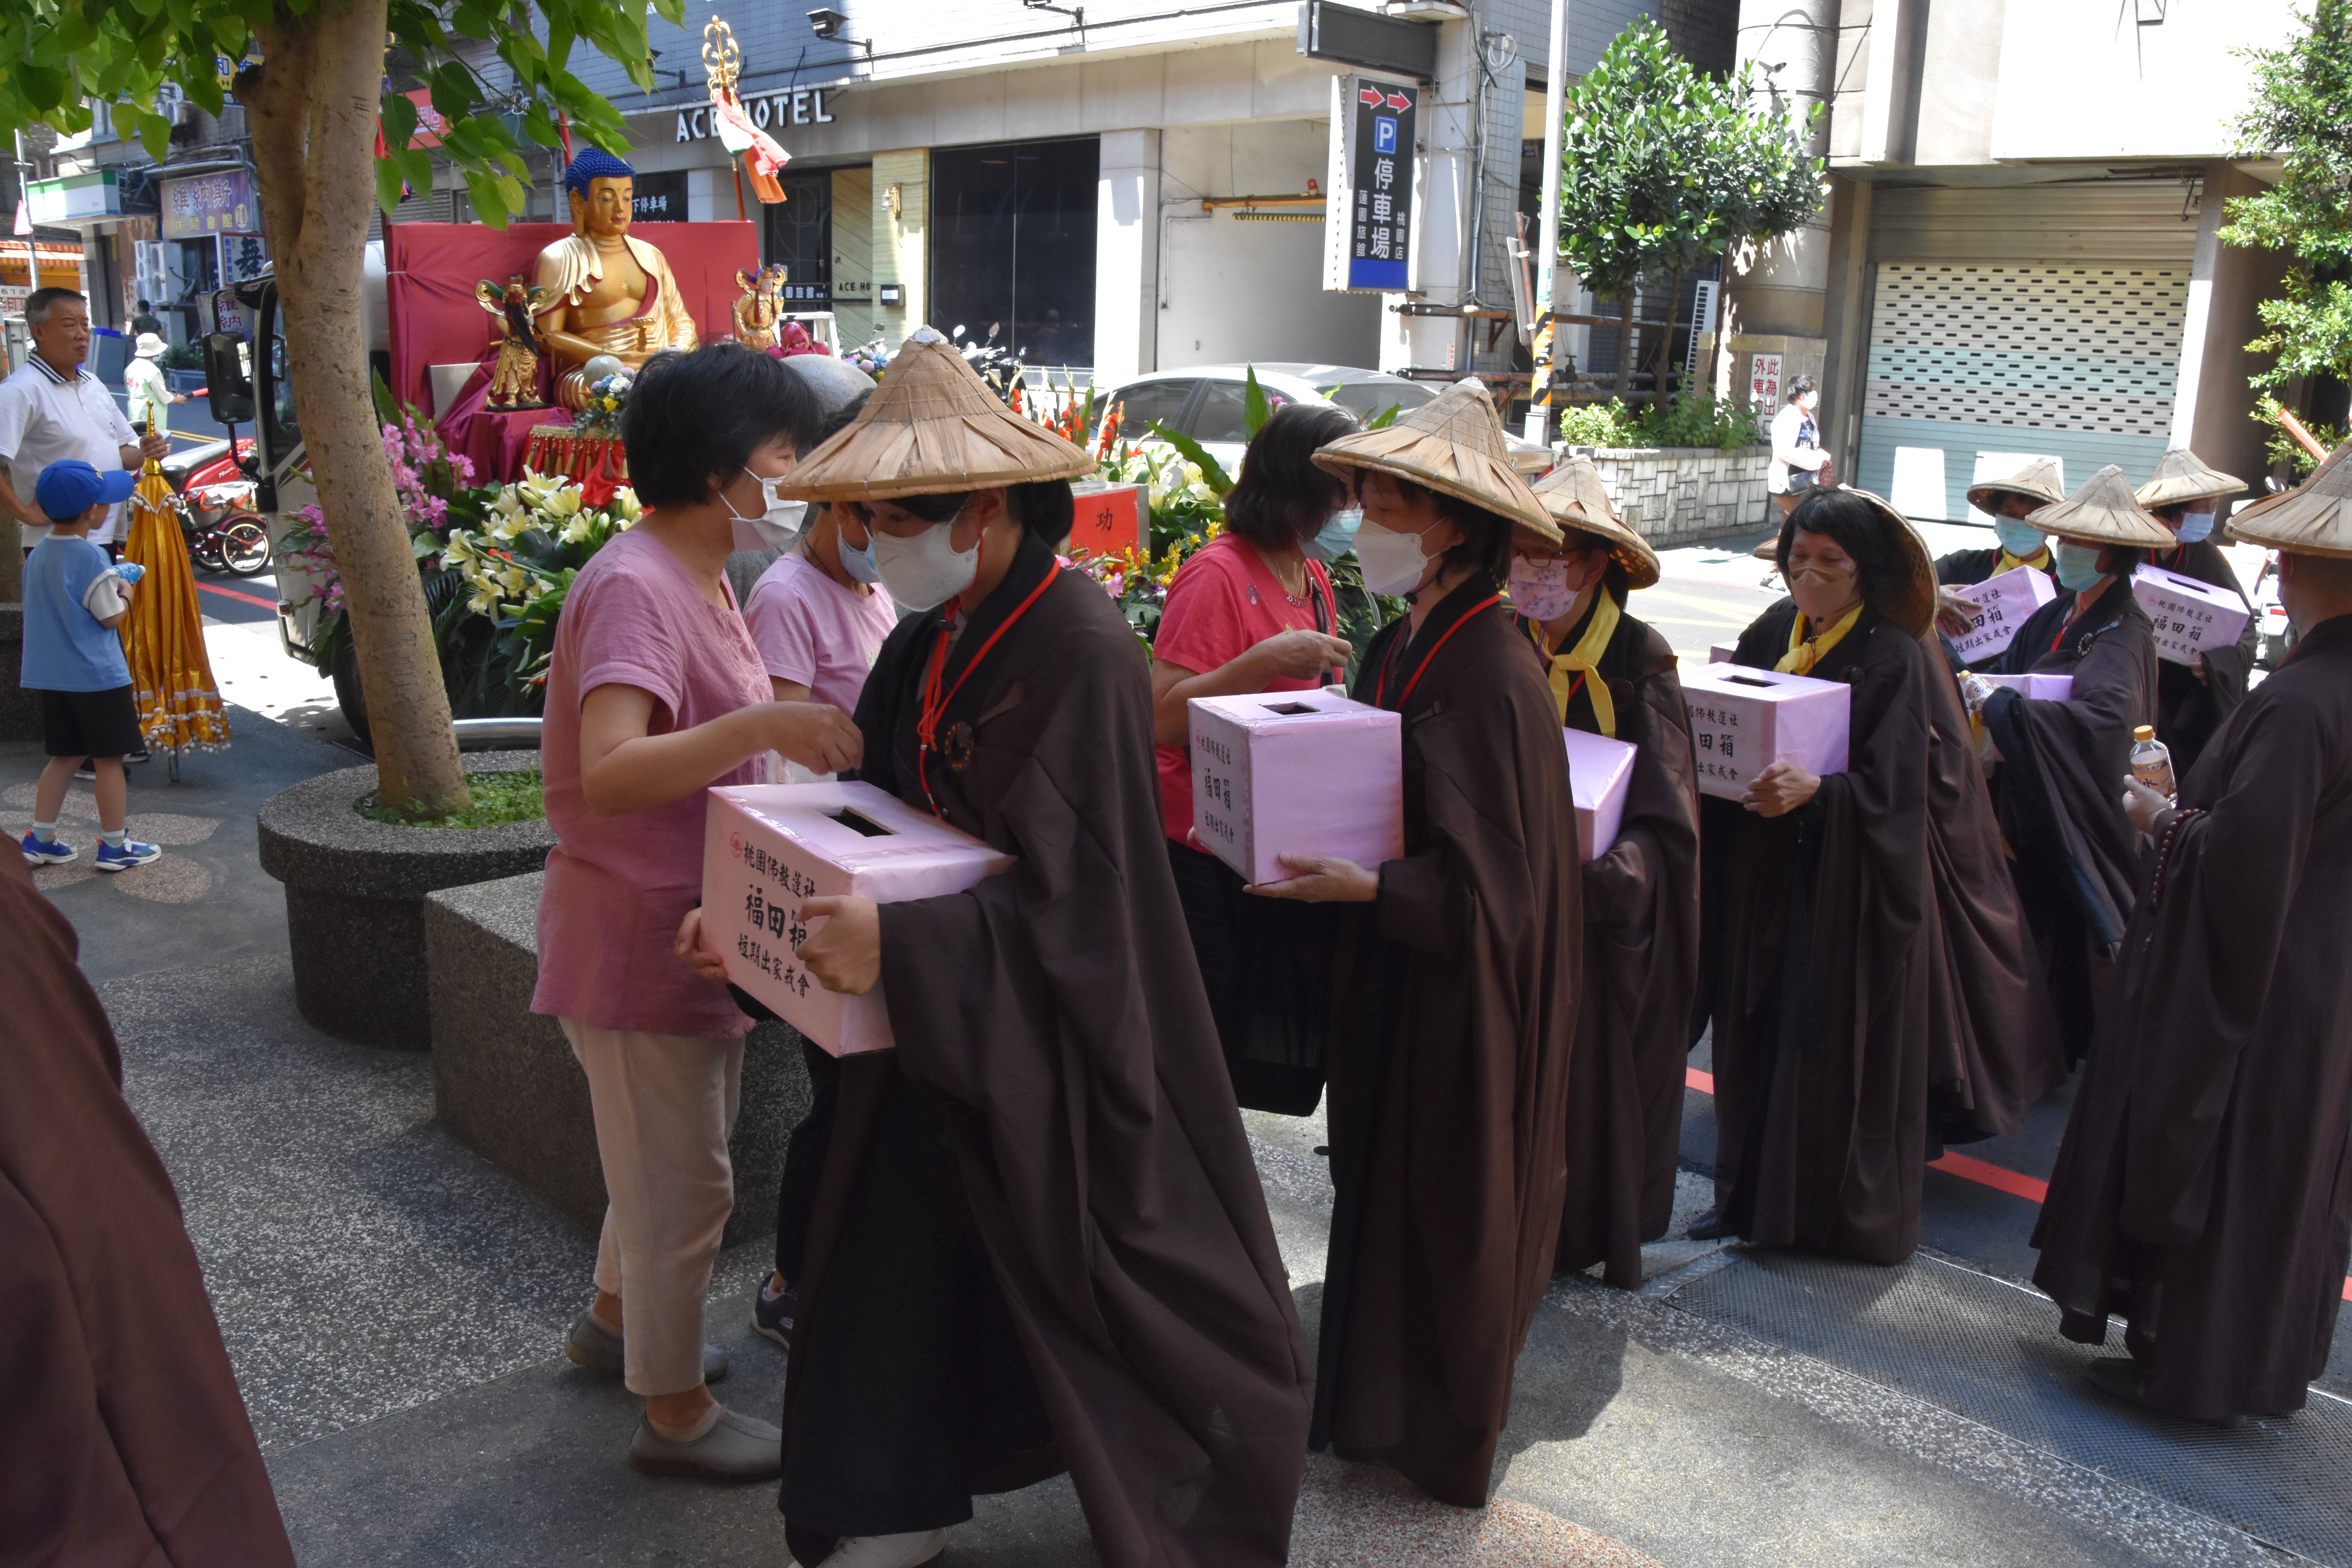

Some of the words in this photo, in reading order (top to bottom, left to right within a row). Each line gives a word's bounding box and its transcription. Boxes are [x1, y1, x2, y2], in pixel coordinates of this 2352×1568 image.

[676, 105, 720, 143] ACE
[1379, 122, 1393, 148] P
[173, 179, 232, 214] 維納斯
[1370, 157, 1394, 259] 停車場
[1395, 212, 1405, 260] 桃園店
[234, 236, 264, 278] 舞
[838, 282, 856, 291] ACE
[860, 282, 873, 291] HO
[217, 299, 242, 329] 維納
[1763, 358, 1779, 435] 此為出口
[1096, 507, 1113, 532] 功
[2153, 614, 2204, 641] 福田箱
[1699, 732, 1734, 759] 田箱
[1205, 767, 1231, 812] 福田箱
[744, 841, 815, 898] 桃園佛教蓮社
[737, 932, 810, 999] 短期出家戒會
